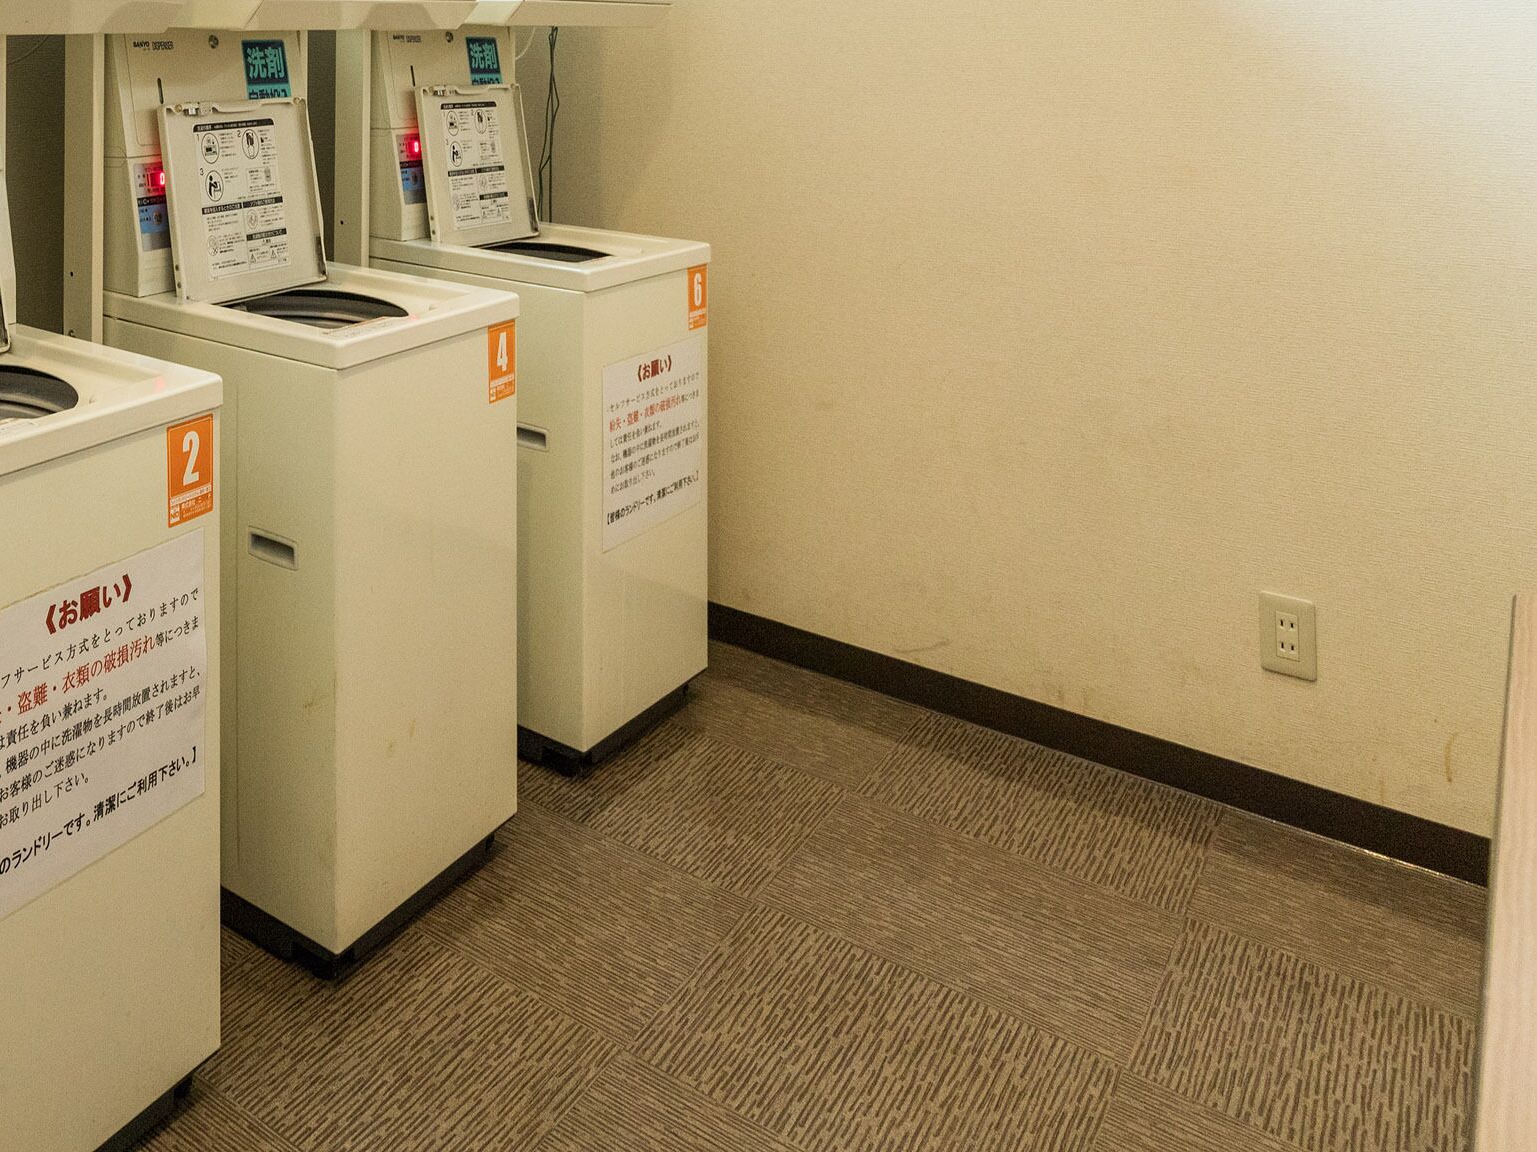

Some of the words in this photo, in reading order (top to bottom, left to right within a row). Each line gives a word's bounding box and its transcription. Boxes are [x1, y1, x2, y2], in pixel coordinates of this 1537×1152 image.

[247, 47, 285, 80] 洗剤
[470, 43, 498, 69] 洗剤
[694, 272, 702, 307] 6
[496, 331, 508, 372] 4
[182, 430, 200, 487] 2
